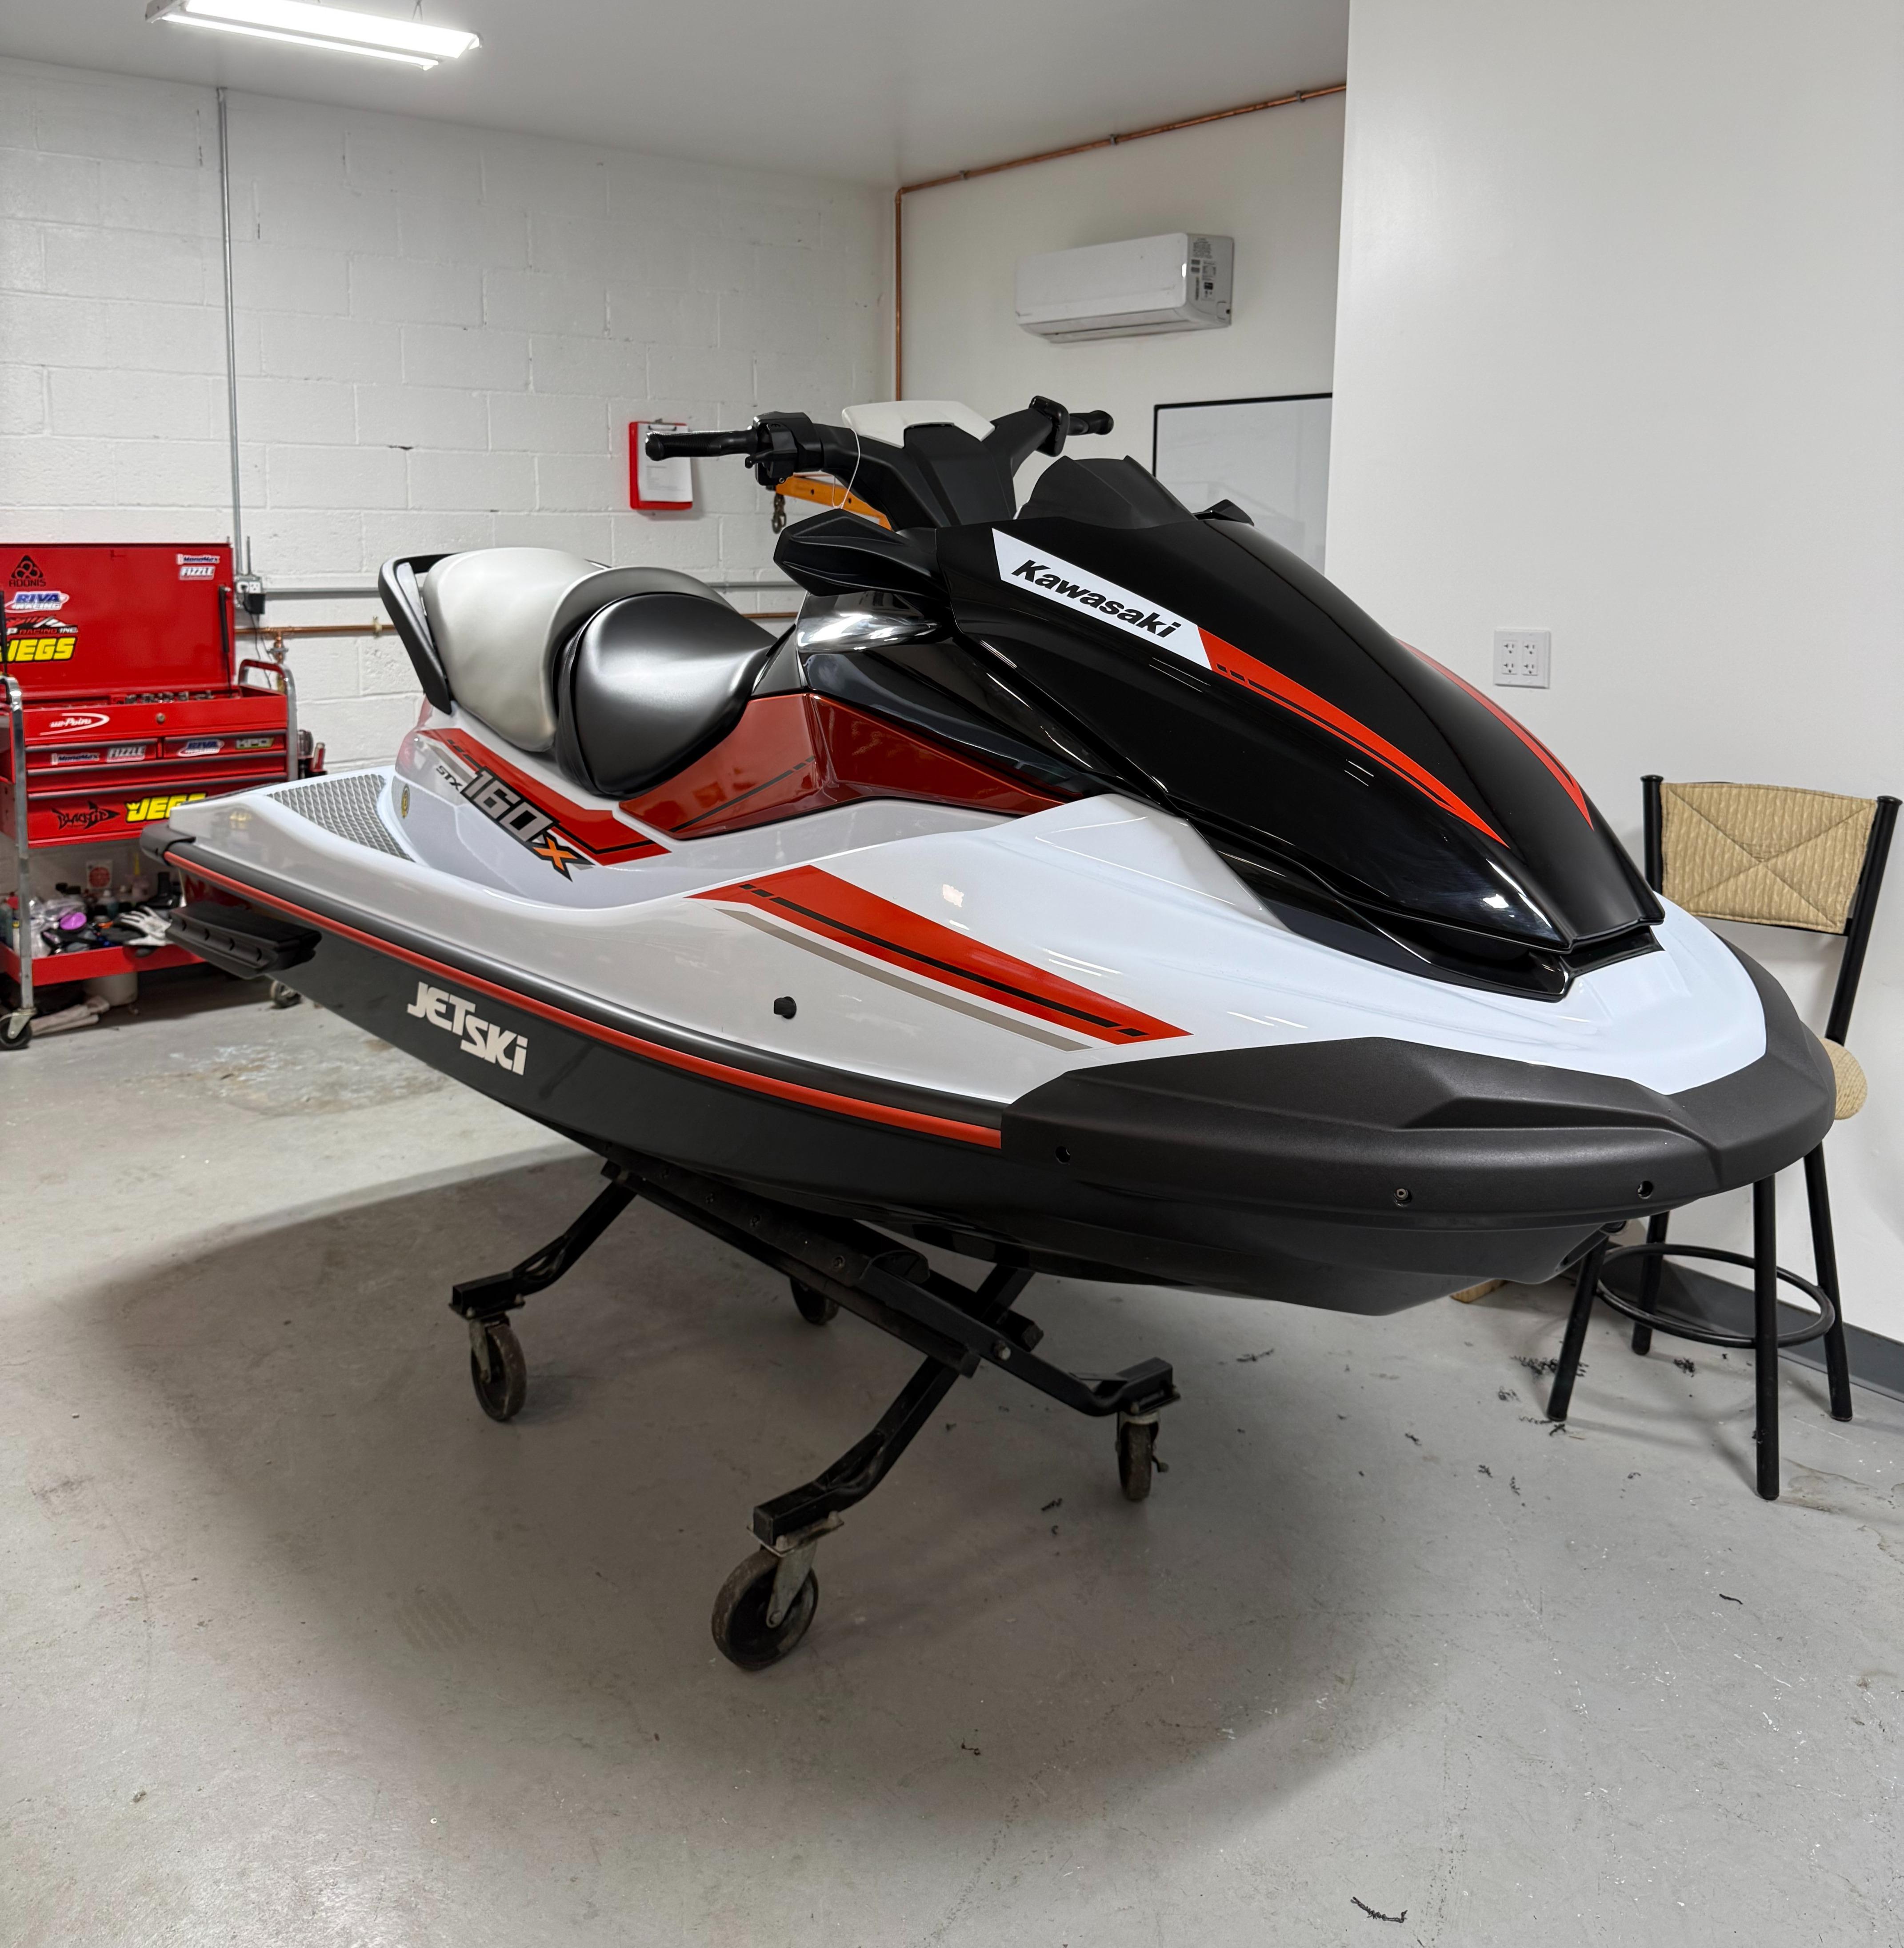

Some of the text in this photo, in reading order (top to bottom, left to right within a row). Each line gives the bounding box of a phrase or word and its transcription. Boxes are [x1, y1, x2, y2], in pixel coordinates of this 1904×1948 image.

[9, 579, 46, 587] ADONIS
[16, 593, 60, 603] RIVA
[1012, 560, 1181, 637] Kawasaki
[436, 765, 463, 791] STX
